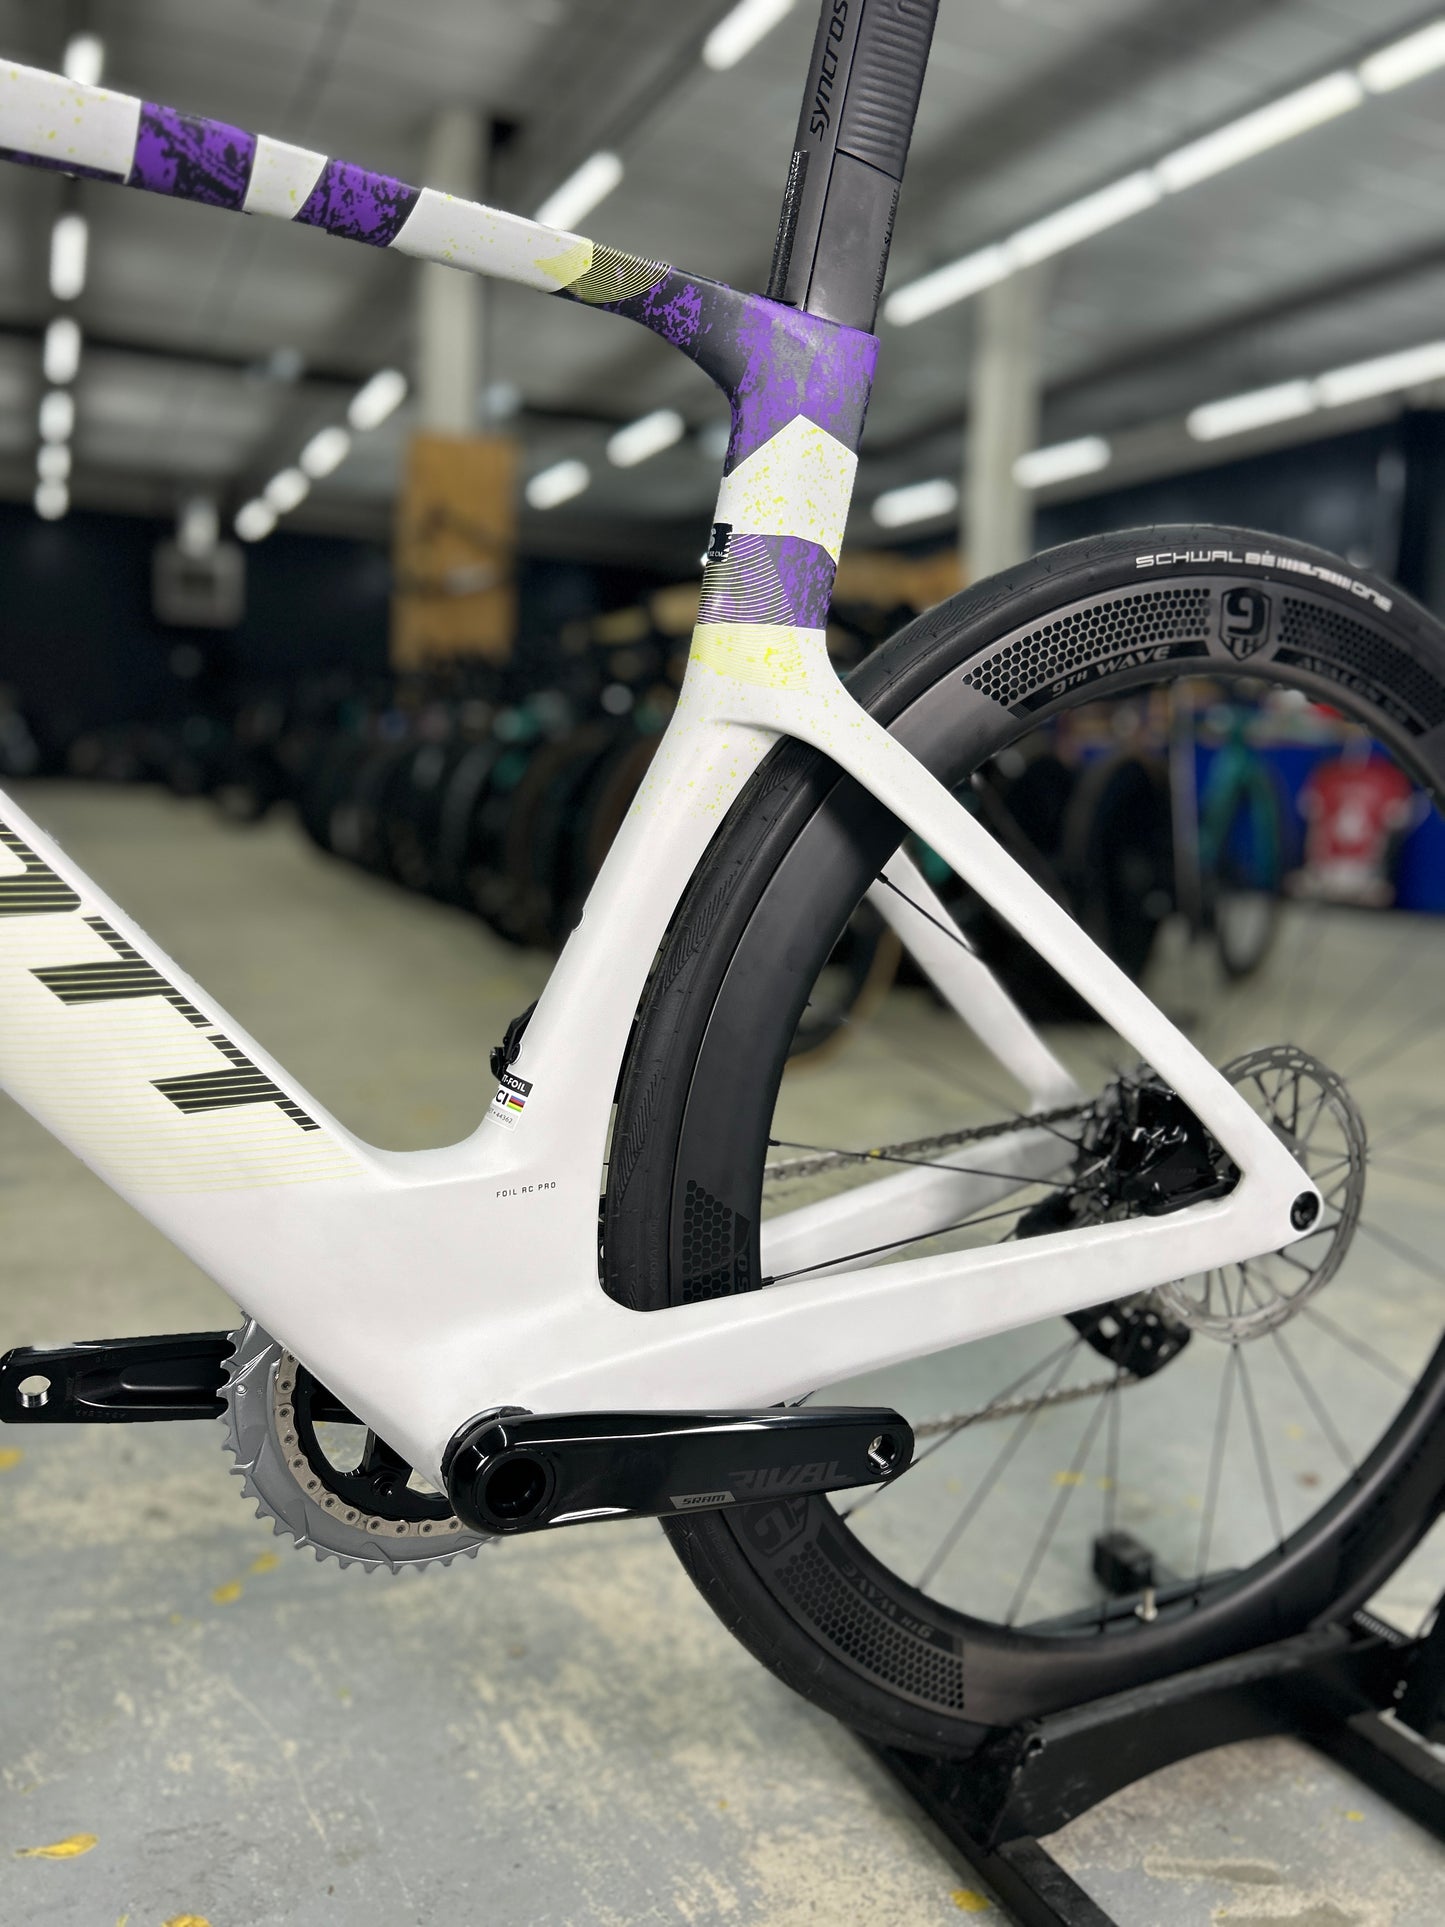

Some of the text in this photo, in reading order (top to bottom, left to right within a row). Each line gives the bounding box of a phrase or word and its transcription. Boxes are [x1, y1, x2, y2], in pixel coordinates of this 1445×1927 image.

[1135, 550, 1277, 569] SCHWALBE
[1051, 645, 1171, 698] 9TH WAVE
[496, 1181, 557, 1198] FOIL RC PRO
[727, 1460, 852, 1490] RIVAL
[681, 1493, 727, 1506] SRAM
[841, 1561, 898, 1622] WAVE
